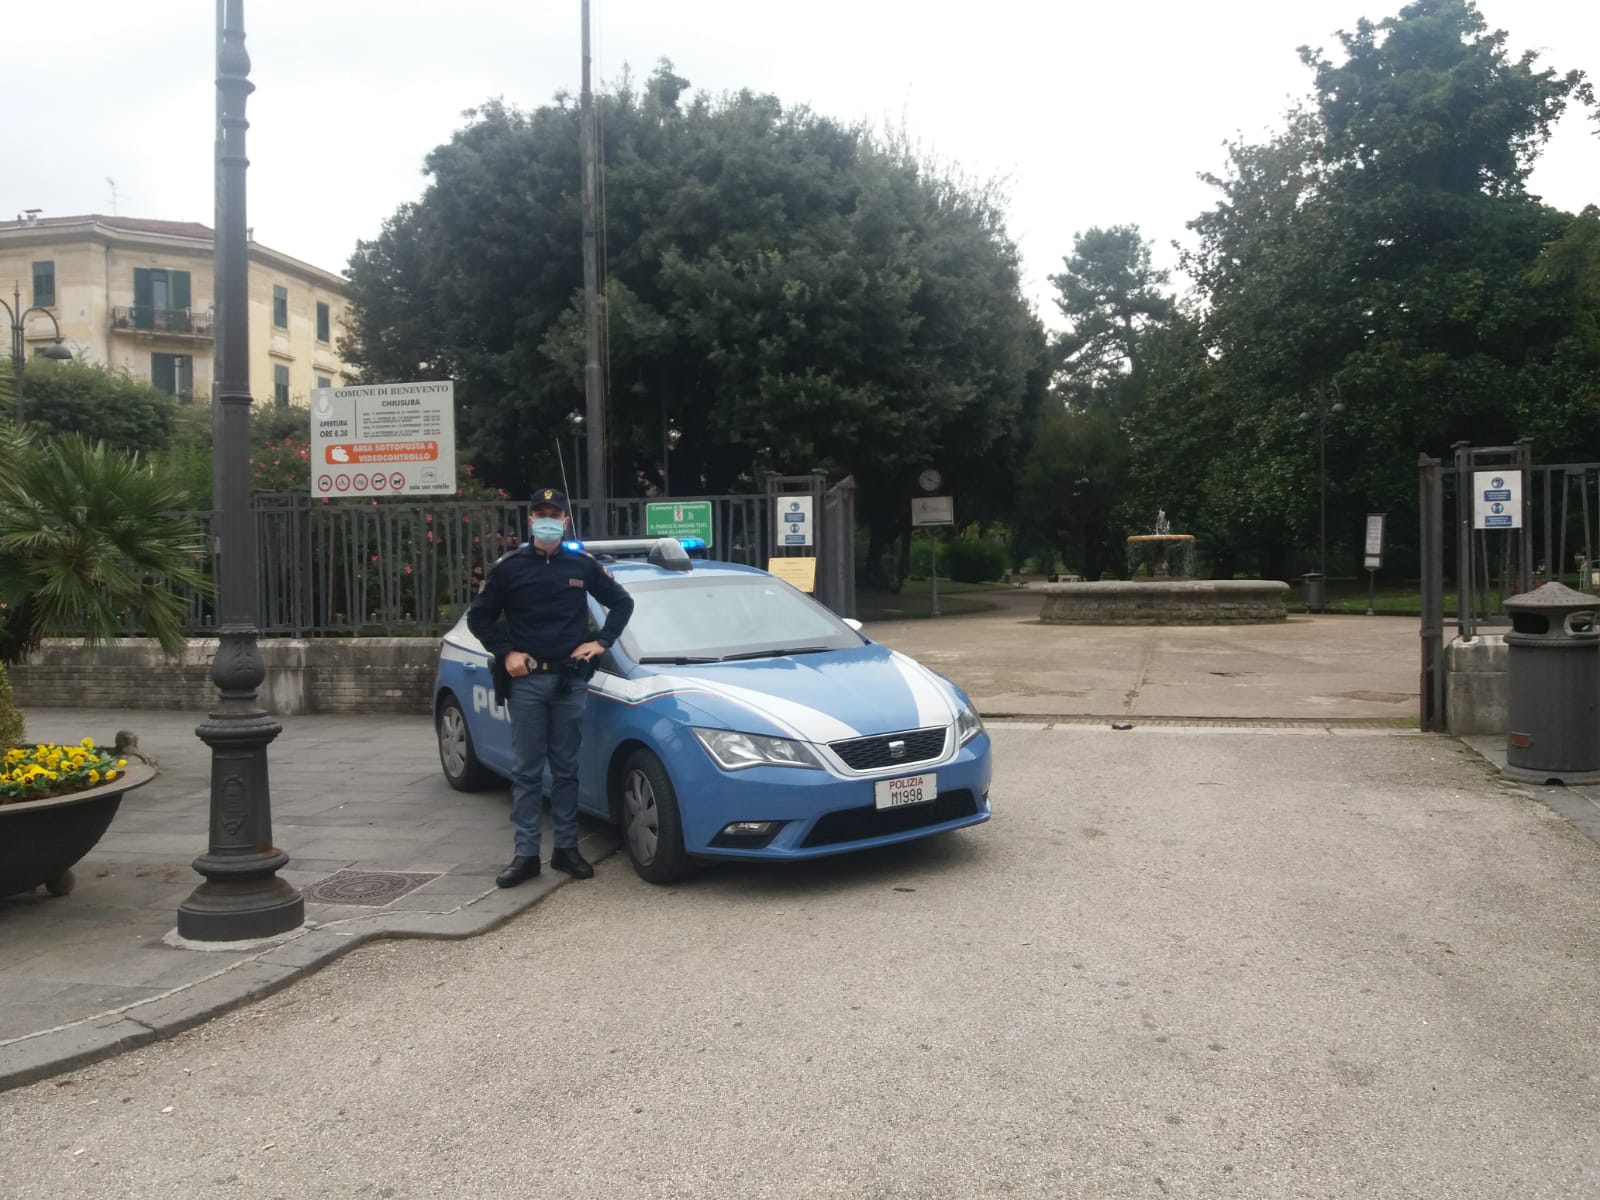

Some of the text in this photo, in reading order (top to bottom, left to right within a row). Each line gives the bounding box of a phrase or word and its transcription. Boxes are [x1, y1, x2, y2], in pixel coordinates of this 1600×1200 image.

[335, 385, 449, 398] COMUNE DI BENEVENTO
[381, 399, 421, 407] CHIUSURA
[319, 430, 333, 438] ORE
[352, 442, 434, 452] AREA SOTTOPOSTA A
[358, 453, 431, 462] VIDEOCONTROLLO
[473, 684, 511, 724] PO
[889, 777, 924, 790] POLIZIA
[891, 788, 923, 805] M1998
